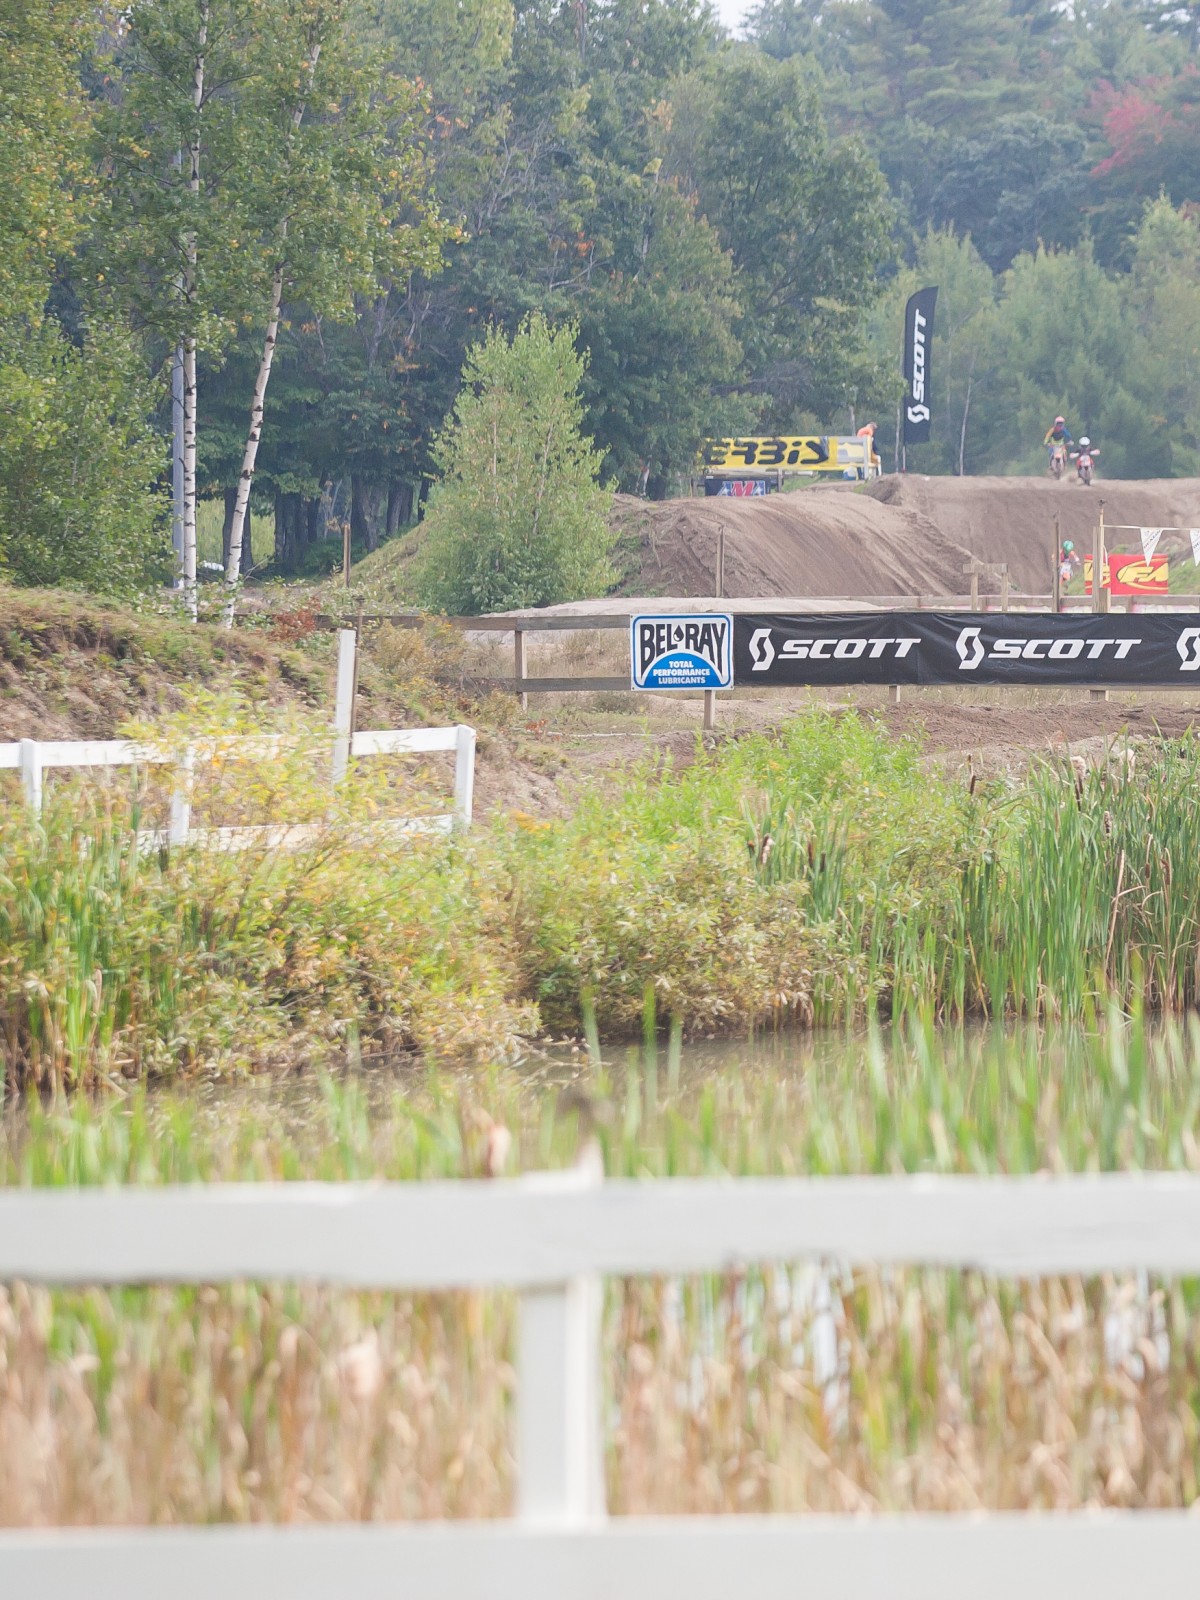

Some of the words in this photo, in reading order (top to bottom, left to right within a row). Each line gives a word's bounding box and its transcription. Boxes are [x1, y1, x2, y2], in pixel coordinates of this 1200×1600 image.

[912, 308, 927, 404] SCOTT
[777, 638, 922, 660] SCOTT
[988, 638, 1142, 659] SCOTT
[668, 660, 694, 669] TOTAL
[652, 668, 711, 677] PERFORMANCE
[658, 676, 706, 685] LUBRICANTS
